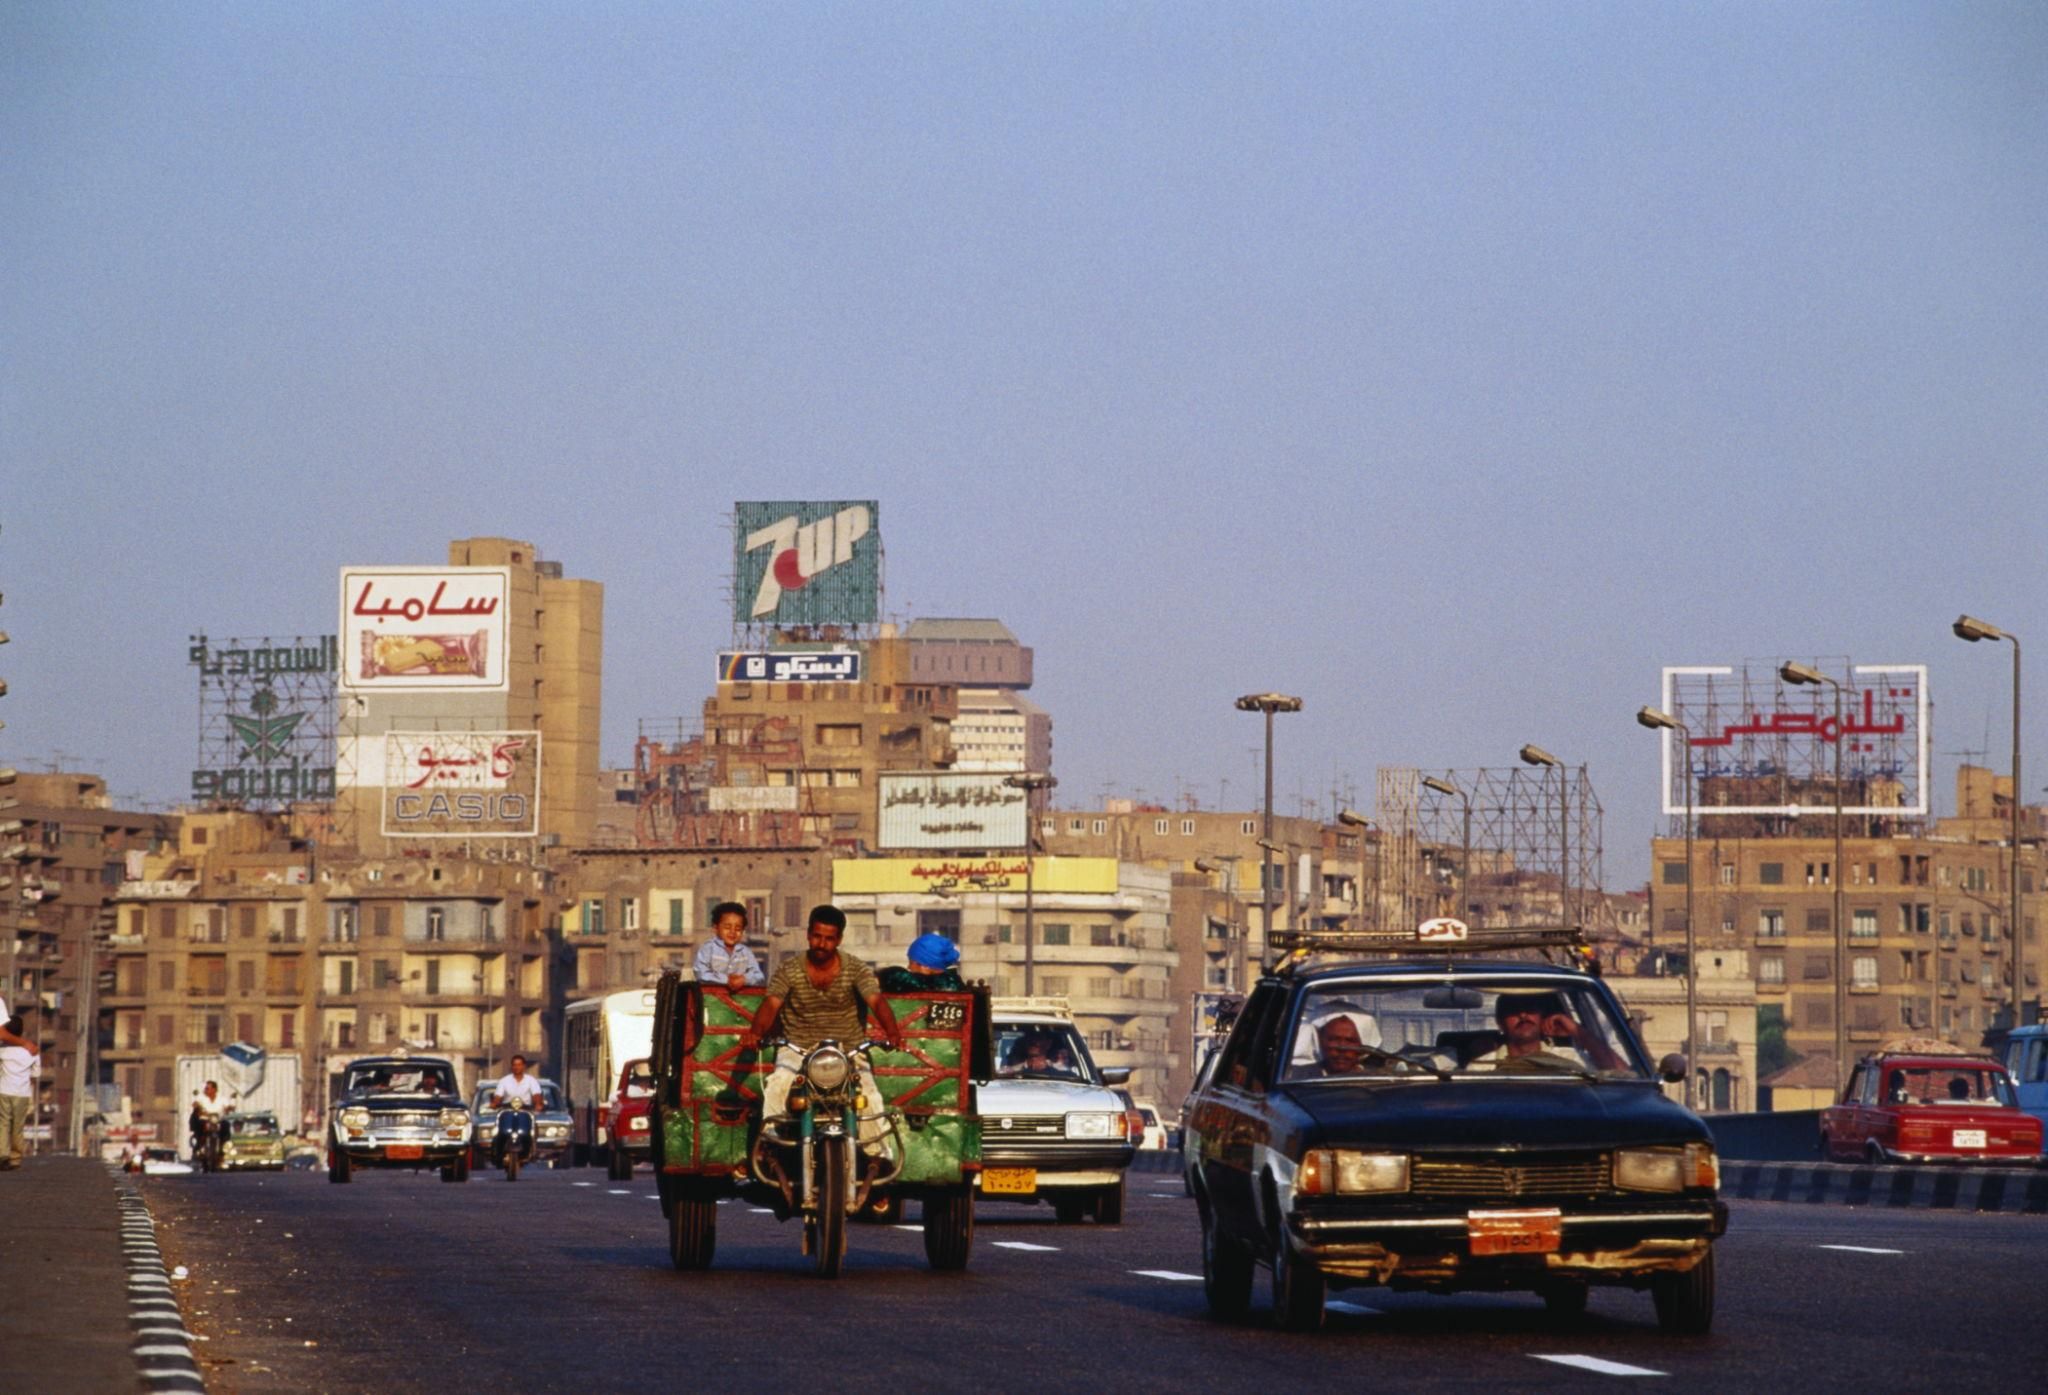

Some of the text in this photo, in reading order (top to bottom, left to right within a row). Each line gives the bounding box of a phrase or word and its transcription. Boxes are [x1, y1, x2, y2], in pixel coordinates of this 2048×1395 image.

[746, 504, 870, 617] 7UP
[353, 581, 499, 624] سامبا
[189, 634, 337, 687] السعودية
[191, 756, 336, 799] saudia
[405, 740, 526, 789] كاسيو
[396, 794, 526, 820] CASIO
